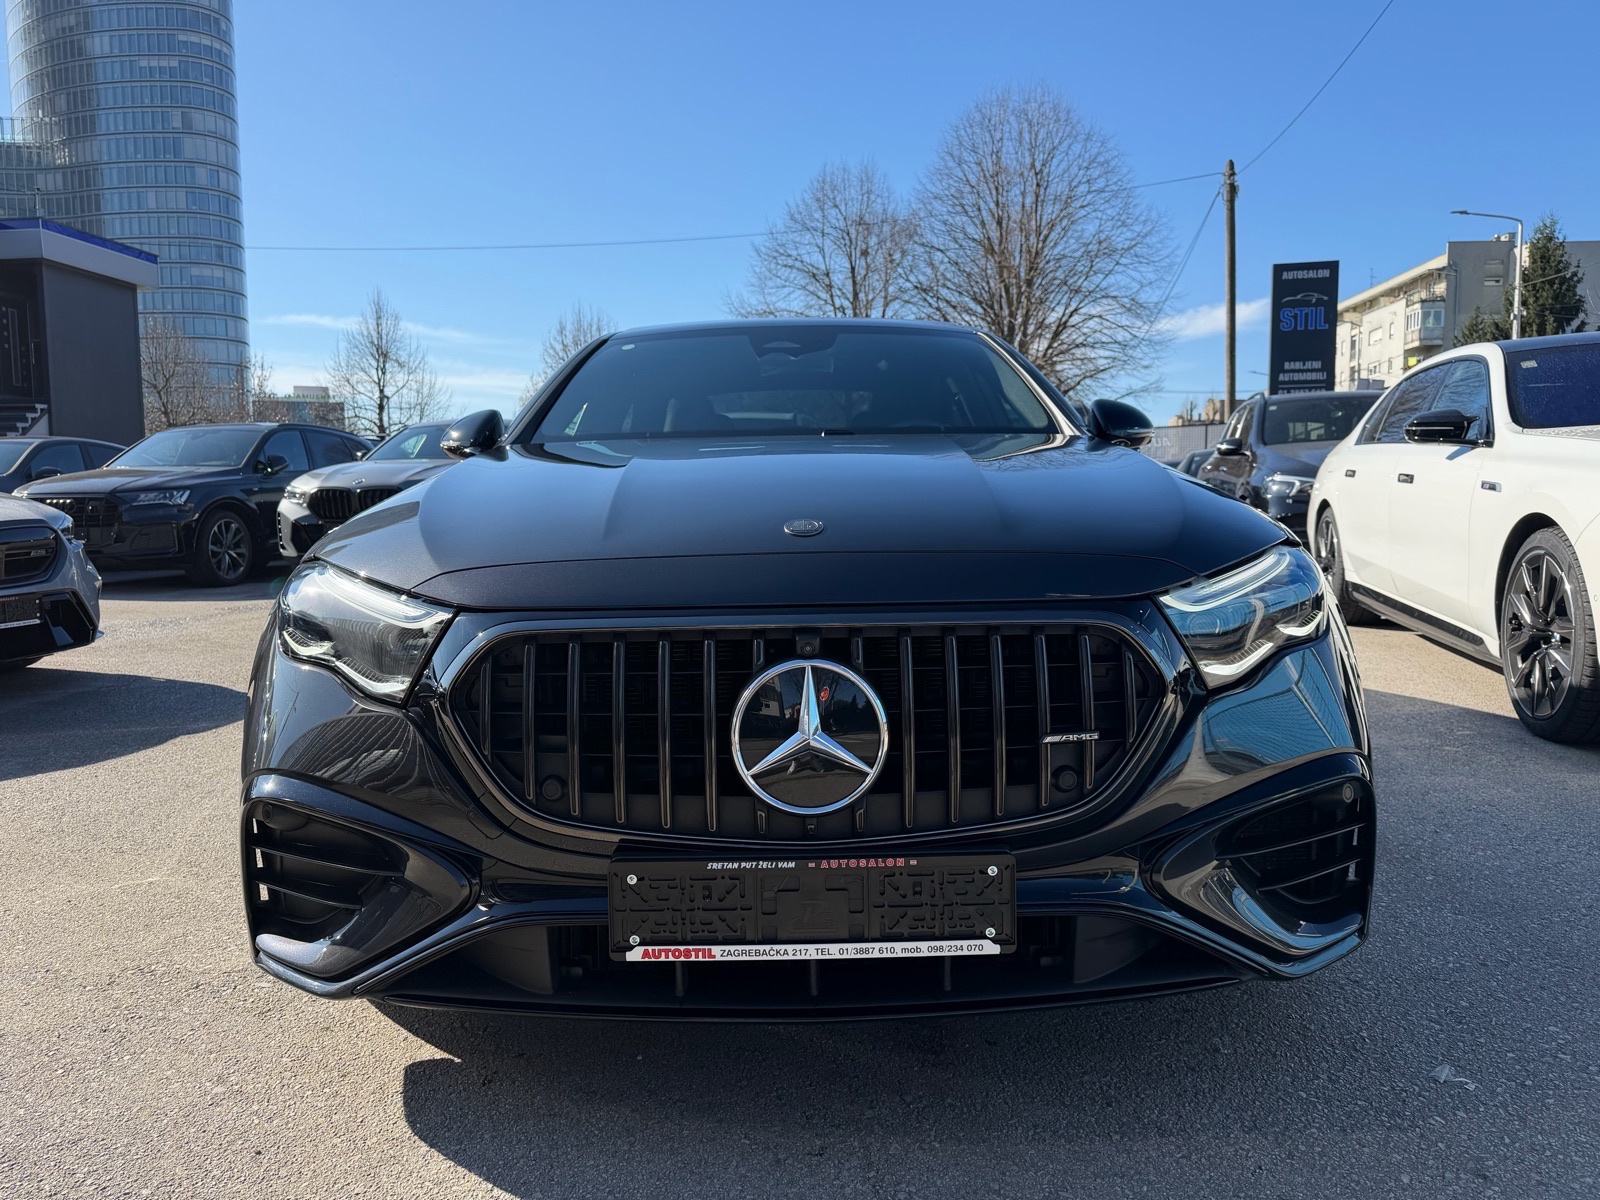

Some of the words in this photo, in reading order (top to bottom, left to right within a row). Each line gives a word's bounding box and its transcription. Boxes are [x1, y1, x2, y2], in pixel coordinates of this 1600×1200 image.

[1282, 269, 1330, 280] AUTOSALON
[1280, 307, 1329, 331] STIL
[1279, 372, 1327, 381] AUTOMOBILI
[1060, 732, 1099, 742] AMG
[707, 862, 739, 870] SRETAN
[758, 861, 776, 869] ŽELI
[777, 861, 796, 869] VAM
[820, 858, 905, 869] AUTOSALON
[641, 948, 716, 960] AUTOSTIL
[720, 947, 789, 958] ZAGREBAČKA
[792, 948, 812, 958] 217,
[815, 948, 836, 957] TEL.
[838, 947, 876, 956] 01/3887
[878, 946, 898, 956] 610,
[901, 945, 925, 954] mob.
[927, 944, 964, 953] 098/234
[966, 943, 984, 952] 070
